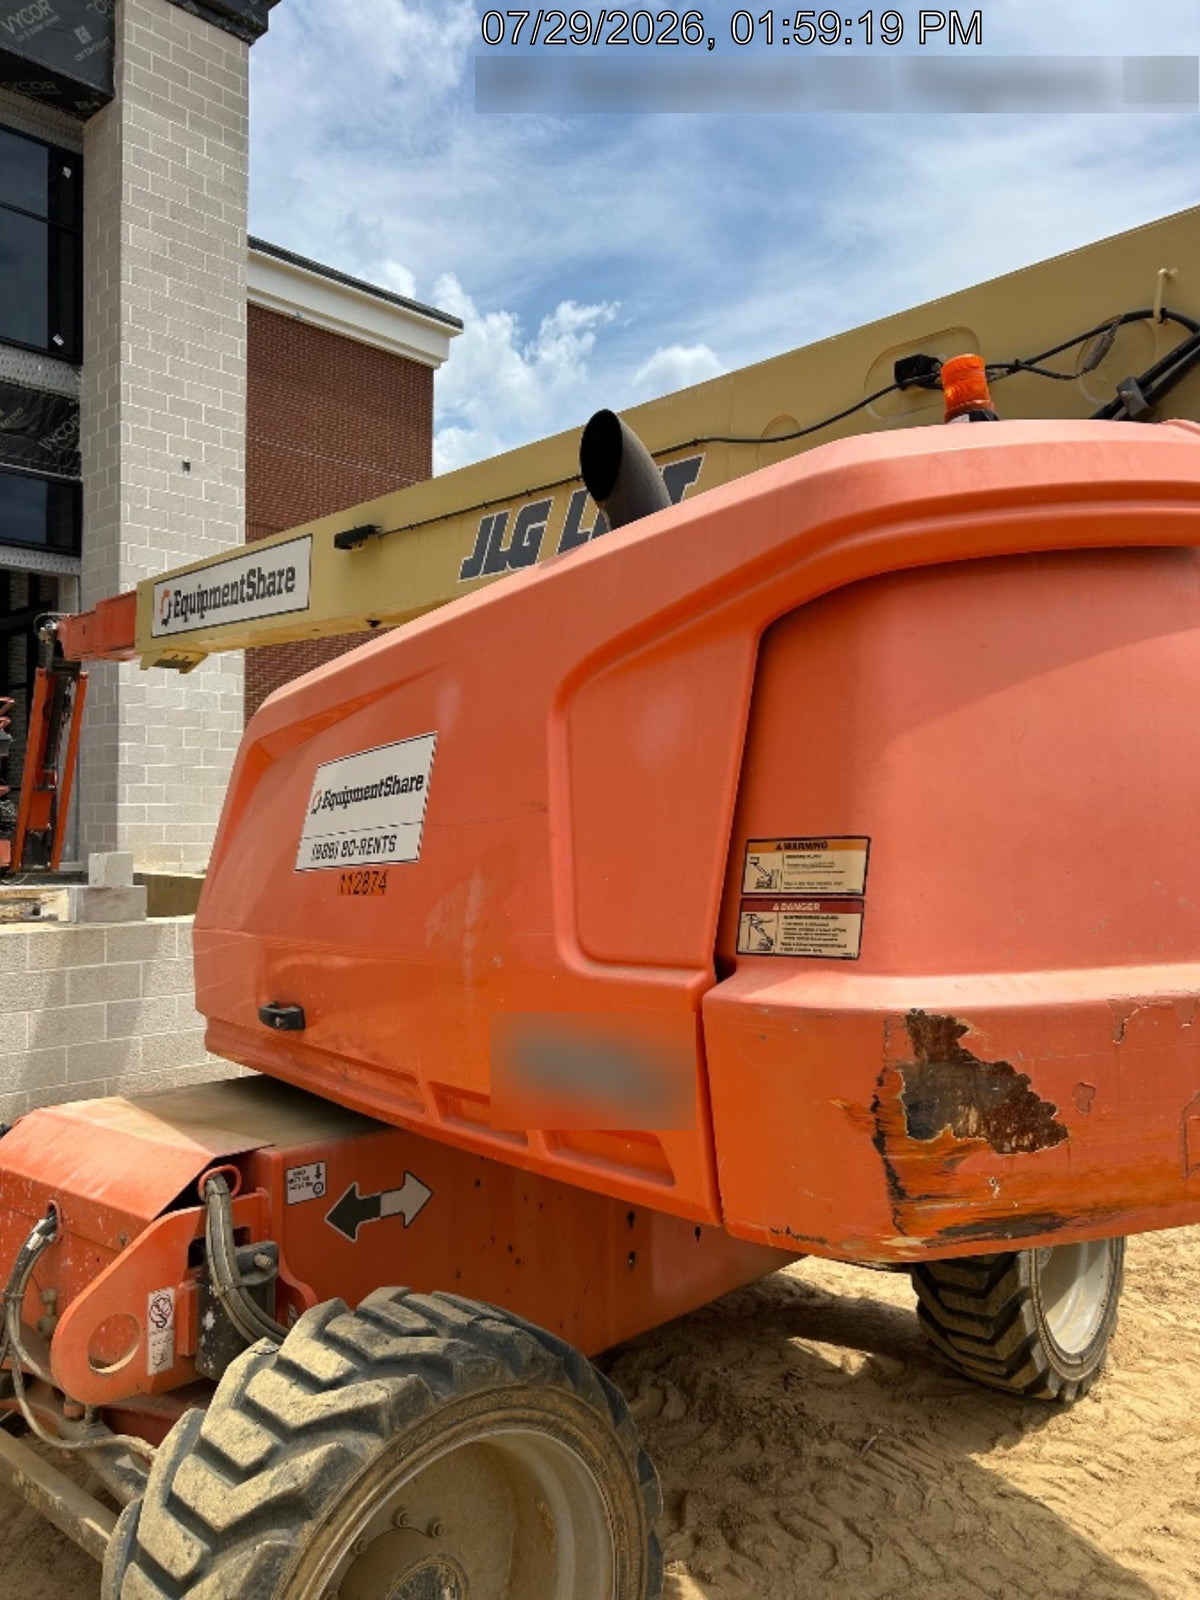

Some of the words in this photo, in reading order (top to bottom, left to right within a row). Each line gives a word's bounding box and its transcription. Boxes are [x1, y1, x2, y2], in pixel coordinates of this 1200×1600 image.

[0, 0, 55, 34] VYCOR
[457, 496, 555, 583] JLG
[555, 452, 706, 556] LT
[173, 566, 296, 622] EquipmentShare
[321, 774, 424, 811] EquipmentShare
[340, 870, 388, 894] 112874
[780, 902, 821, 911] DANGER
